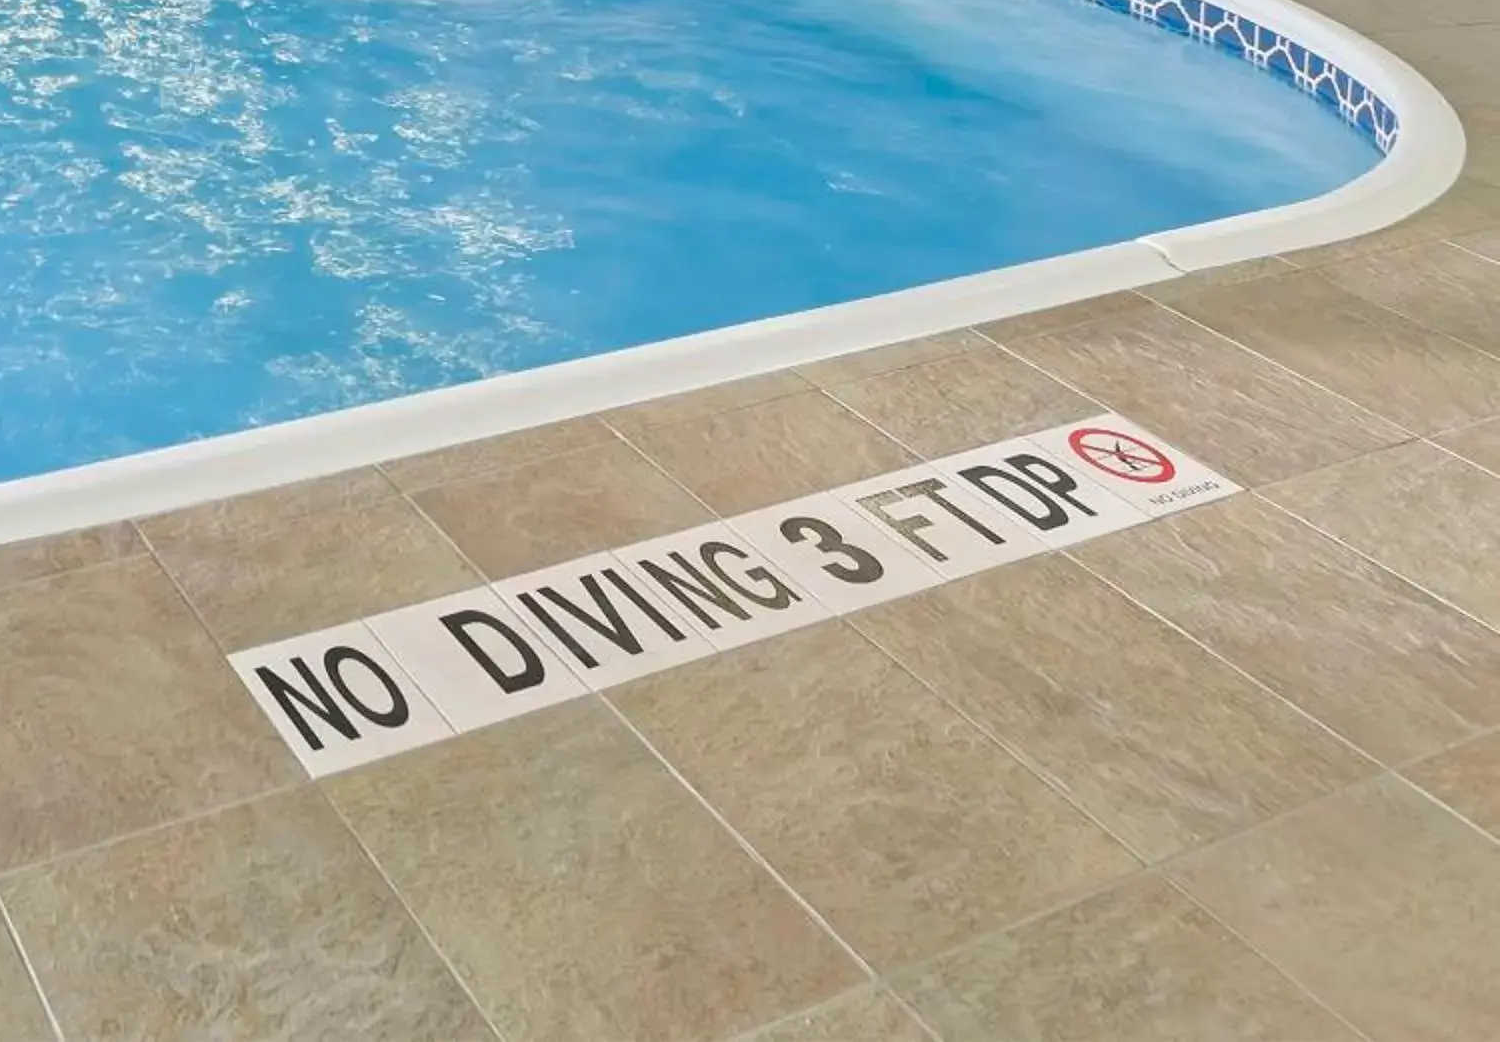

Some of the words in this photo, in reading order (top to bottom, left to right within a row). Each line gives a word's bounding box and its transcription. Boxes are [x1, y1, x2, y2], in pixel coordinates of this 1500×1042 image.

[255, 646, 409, 751] NO
[439, 541, 802, 694] DIVING
[779, 517, 884, 584] 3
